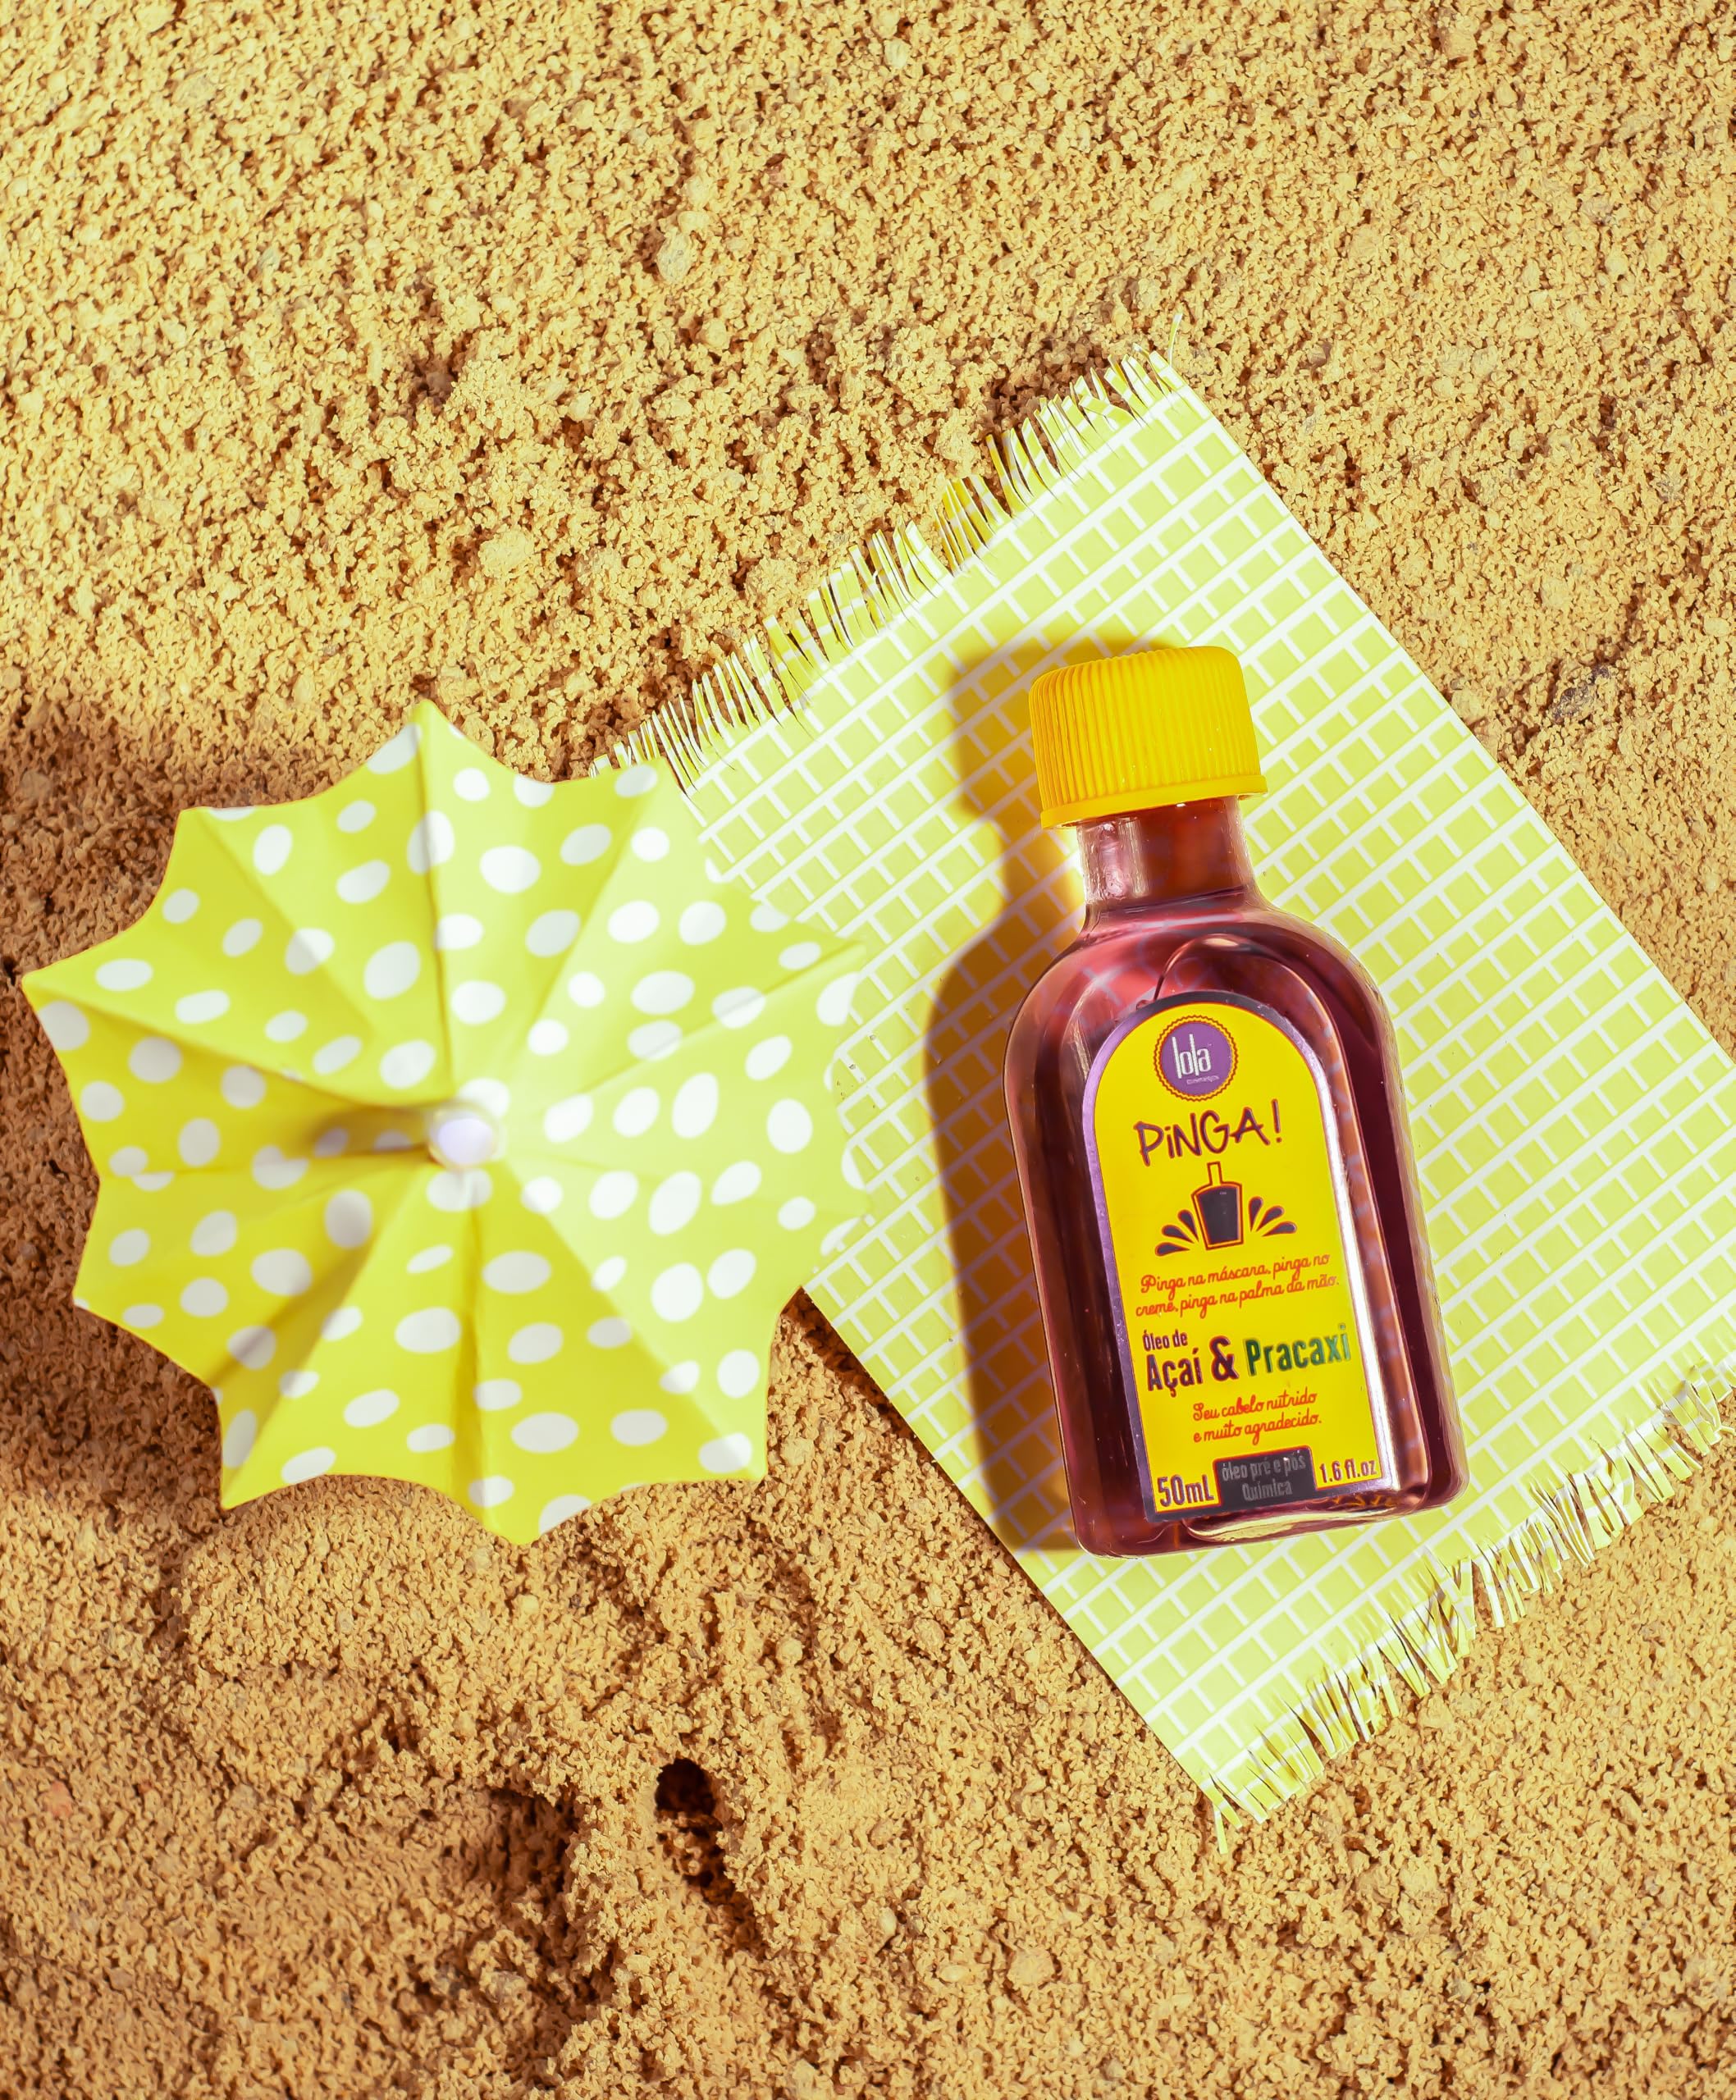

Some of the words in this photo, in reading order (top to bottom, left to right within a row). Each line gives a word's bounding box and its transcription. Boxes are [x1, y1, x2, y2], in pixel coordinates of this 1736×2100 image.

[1172, 1034, 1211, 1079] lola
[1141, 1275, 1185, 1300] Pinga
[1188, 1275, 1205, 1286] na
[1272, 1257, 1311, 1282] pinga
[1313, 1254, 1330, 1266] no
[1180, 1294, 1217, 1319] pinga
[1219, 1292, 1237, 1304] na
[1239, 1280, 1284, 1308] palma
[1286, 1276, 1304, 1293] da
[1306, 1274, 1340, 1290] mão.
[1142, 1330, 1170, 1352] Óleo
[1172, 1329, 1188, 1347] de
[1145, 1348, 1204, 1397] Açaí
[1209, 1335, 1240, 1381] &
[1244, 1323, 1351, 1376] Pracaxi
[1193, 1403, 1220, 1421] Seu
[1222, 1395, 1264, 1418] cabelo
[1266, 1386, 1318, 1410] nutrido
[1193, 1432, 1202, 1443] e
[1204, 1420, 1242, 1441] muito
[1244, 1408, 1322, 1446] agradecido.
[1222, 1463, 1247, 1481] óleo
[1249, 1457, 1272, 1477] pré
[1273, 1460, 1281, 1472] e
[1283, 1449, 1306, 1477] pós
[1319, 1460, 1341, 1483] 1.6
[1157, 1474, 1214, 1507] 50mL
